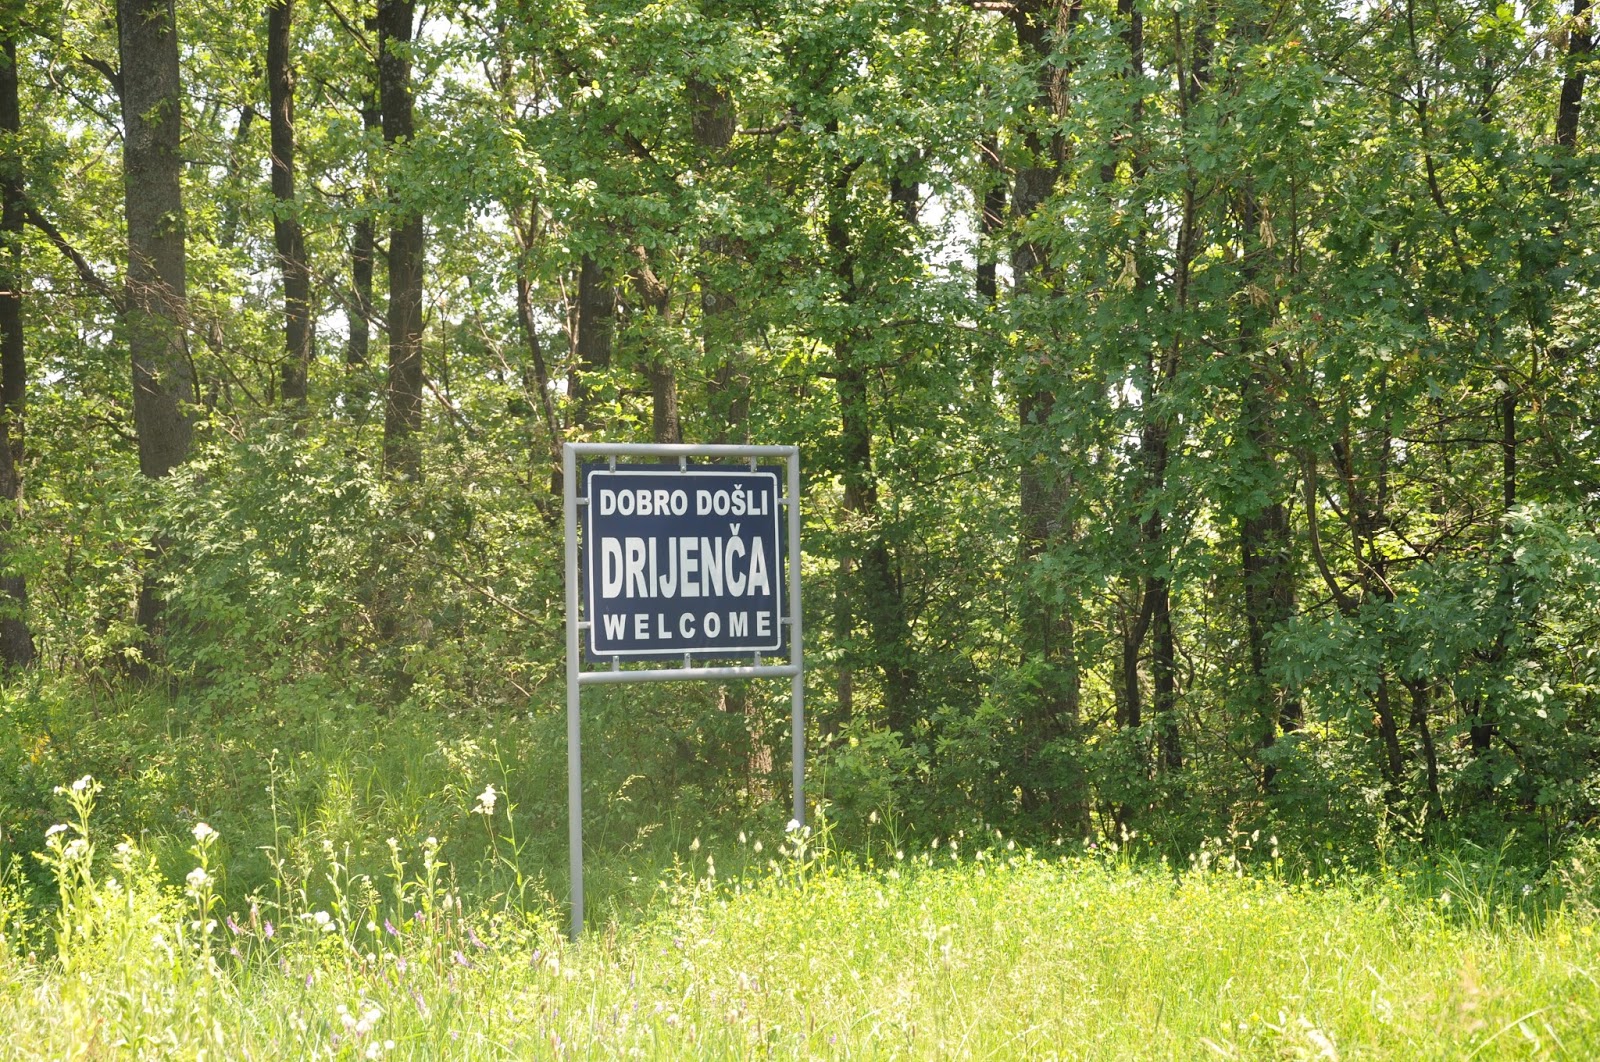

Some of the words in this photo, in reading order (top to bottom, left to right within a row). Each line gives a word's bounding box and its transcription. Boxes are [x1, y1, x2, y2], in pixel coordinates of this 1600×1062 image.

[599, 489, 688, 516] DOBRO
[696, 483, 769, 516] DOŠLI
[601, 522, 771, 599] DRIJENČA
[602, 610, 772, 641] WELCOME
